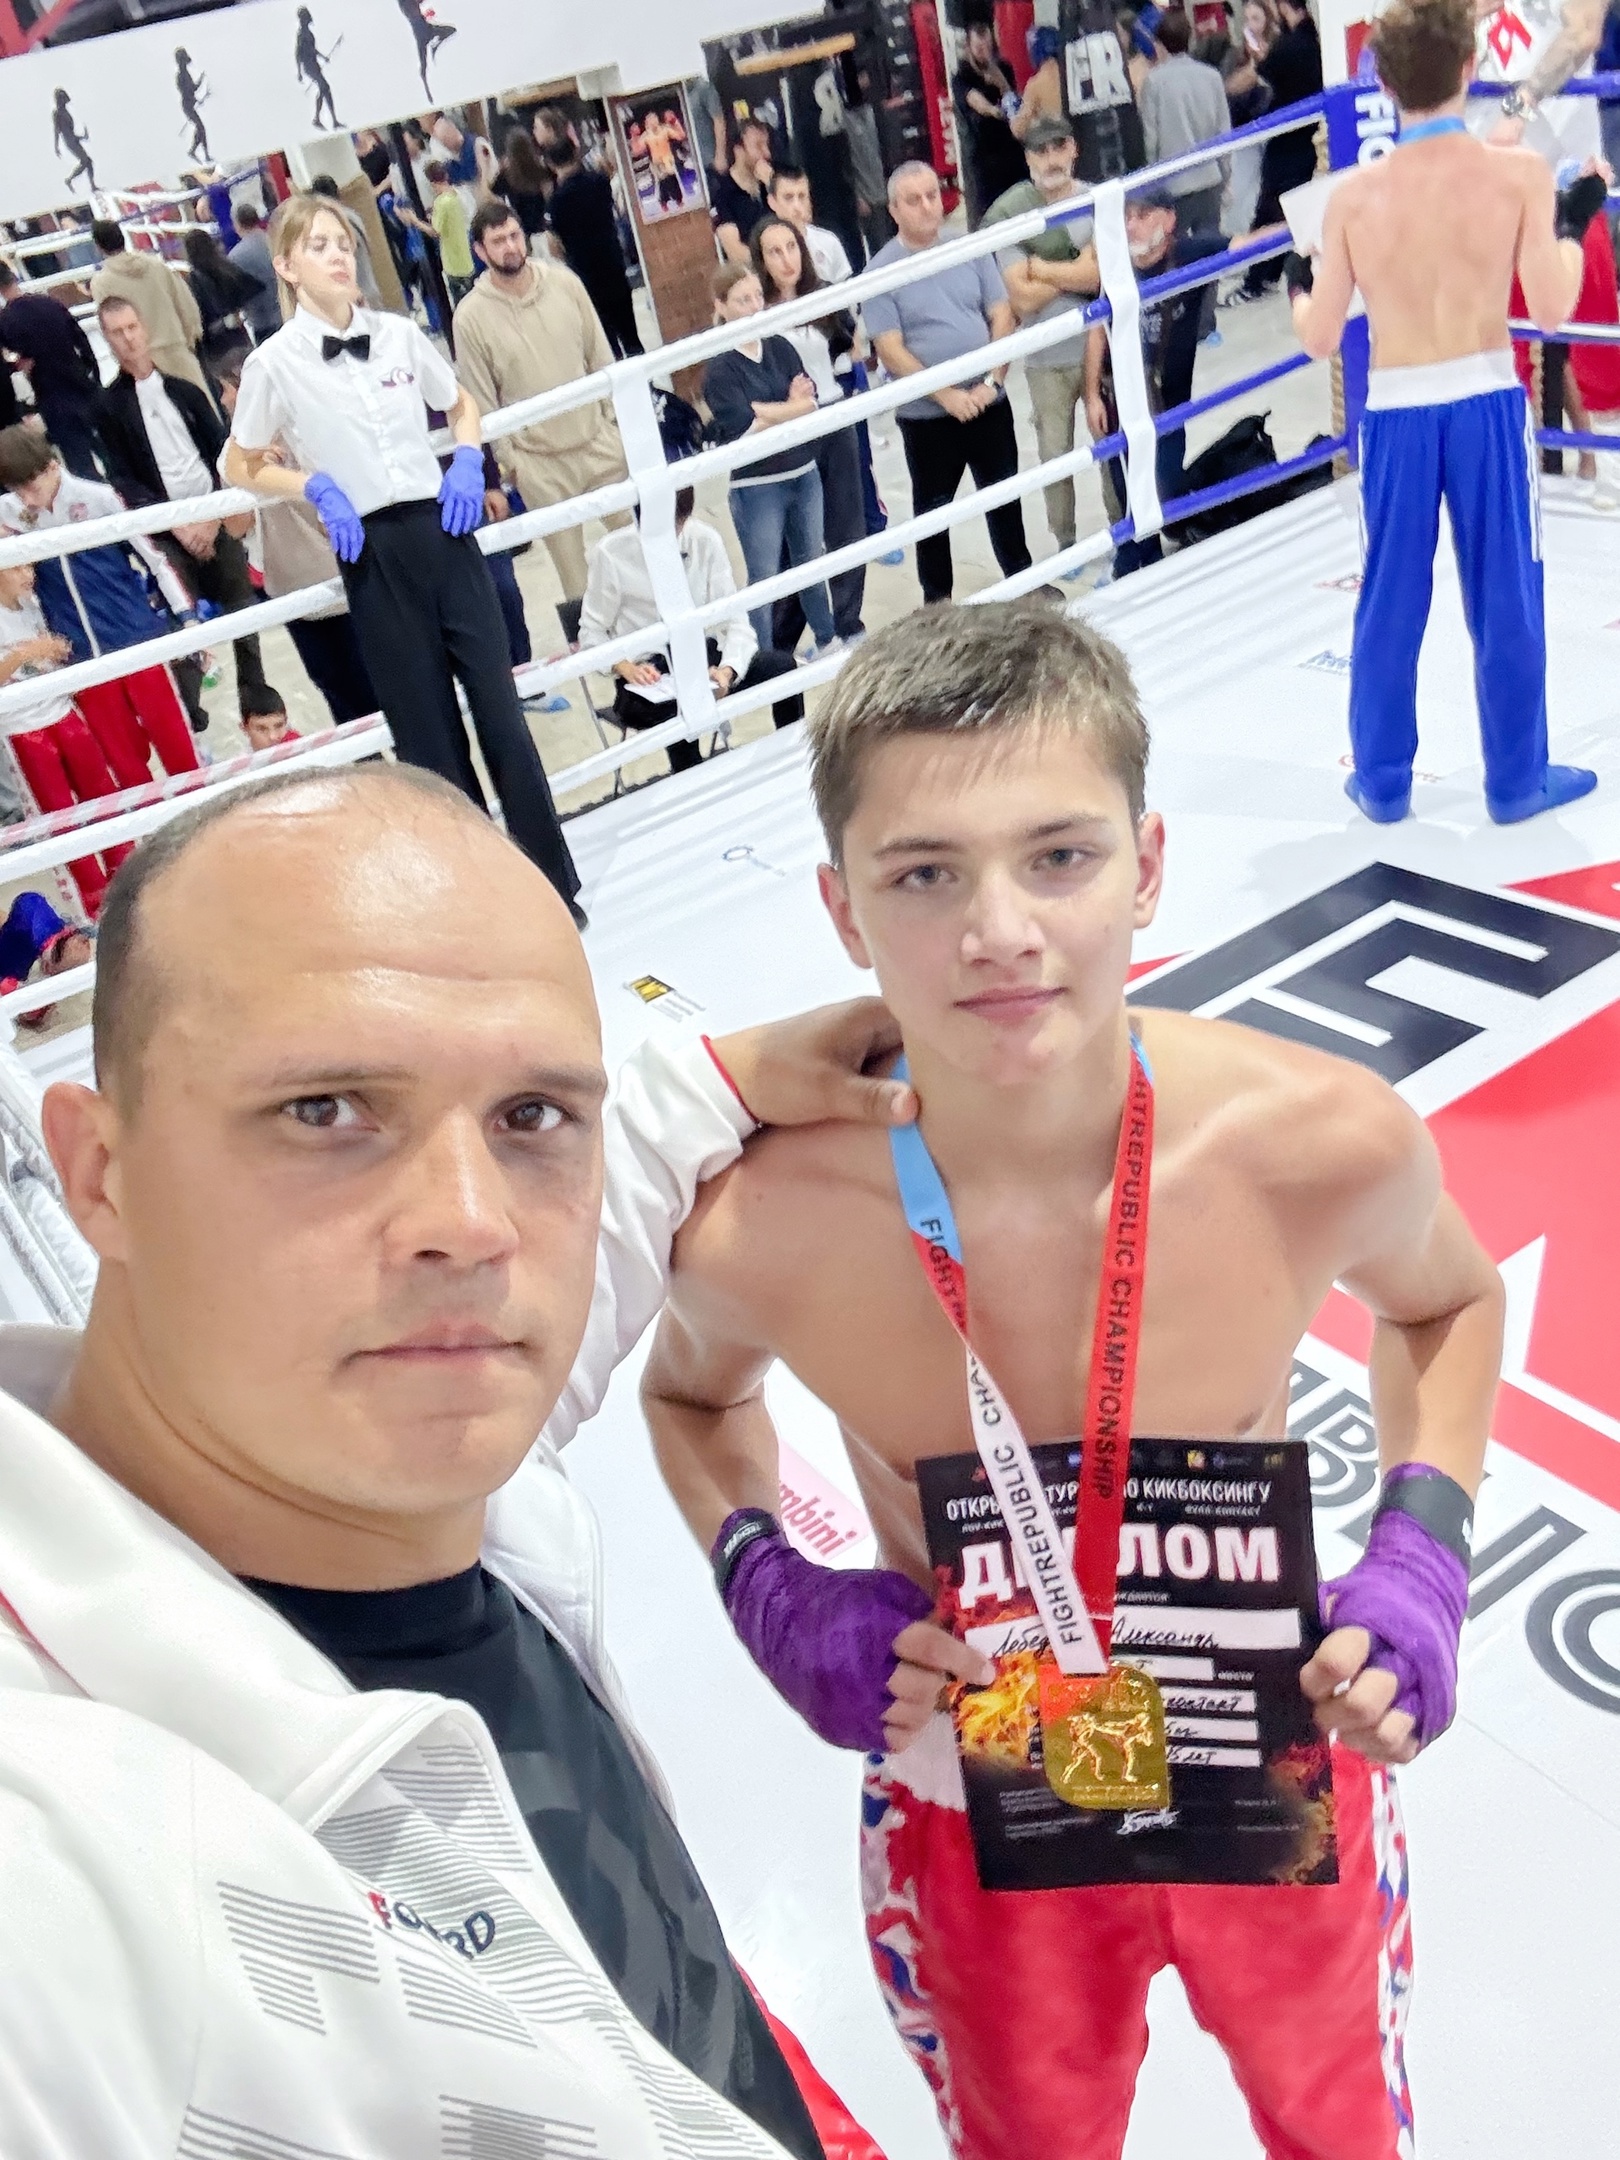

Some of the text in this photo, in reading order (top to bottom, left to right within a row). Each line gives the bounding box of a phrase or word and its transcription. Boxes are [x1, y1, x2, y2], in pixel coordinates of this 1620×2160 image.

[1113, 1076, 1149, 1268] HTREPUBLIC
[969, 1353, 1002, 1428] CHA
[993, 1441, 1083, 1646] FIGHTREPUBLIC
[1044, 1481, 1079, 1505] ТУР
[1142, 1477, 1272, 1503] КИКБОКСИНГУ
